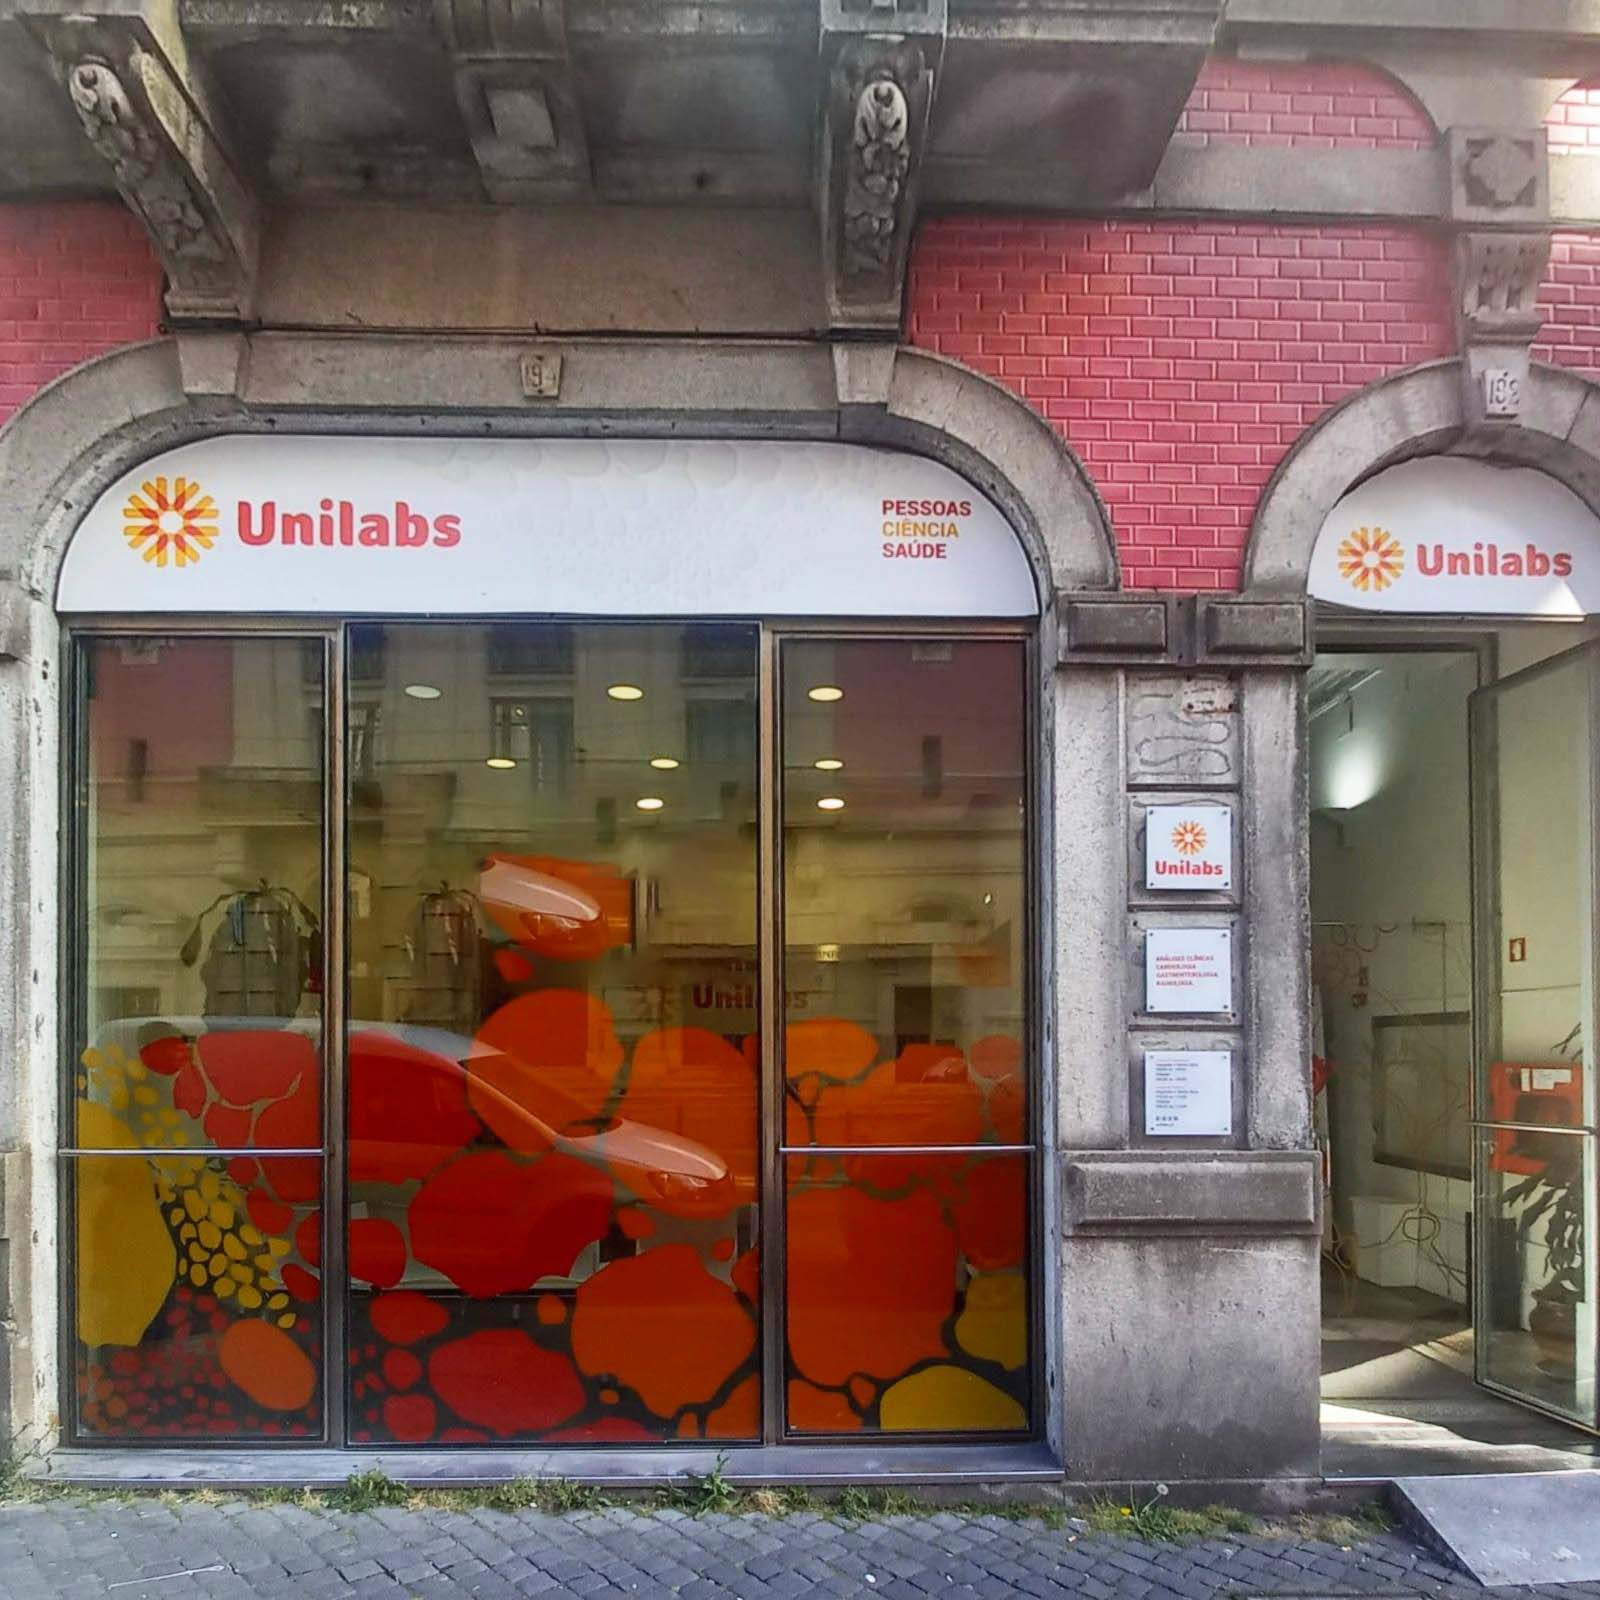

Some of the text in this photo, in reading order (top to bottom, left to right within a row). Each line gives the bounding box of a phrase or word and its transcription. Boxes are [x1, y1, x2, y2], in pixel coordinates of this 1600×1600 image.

[882, 500, 972, 516] PESSOAS
[237, 498, 462, 548] Unilabs
[882, 518, 959, 537] CIÊNCIA
[882, 539, 947, 559] SAÚDE
[1416, 542, 1573, 577] Unilabs
[1155, 859, 1224, 876] Unilabs
[692, 983, 808, 1009] Unils
